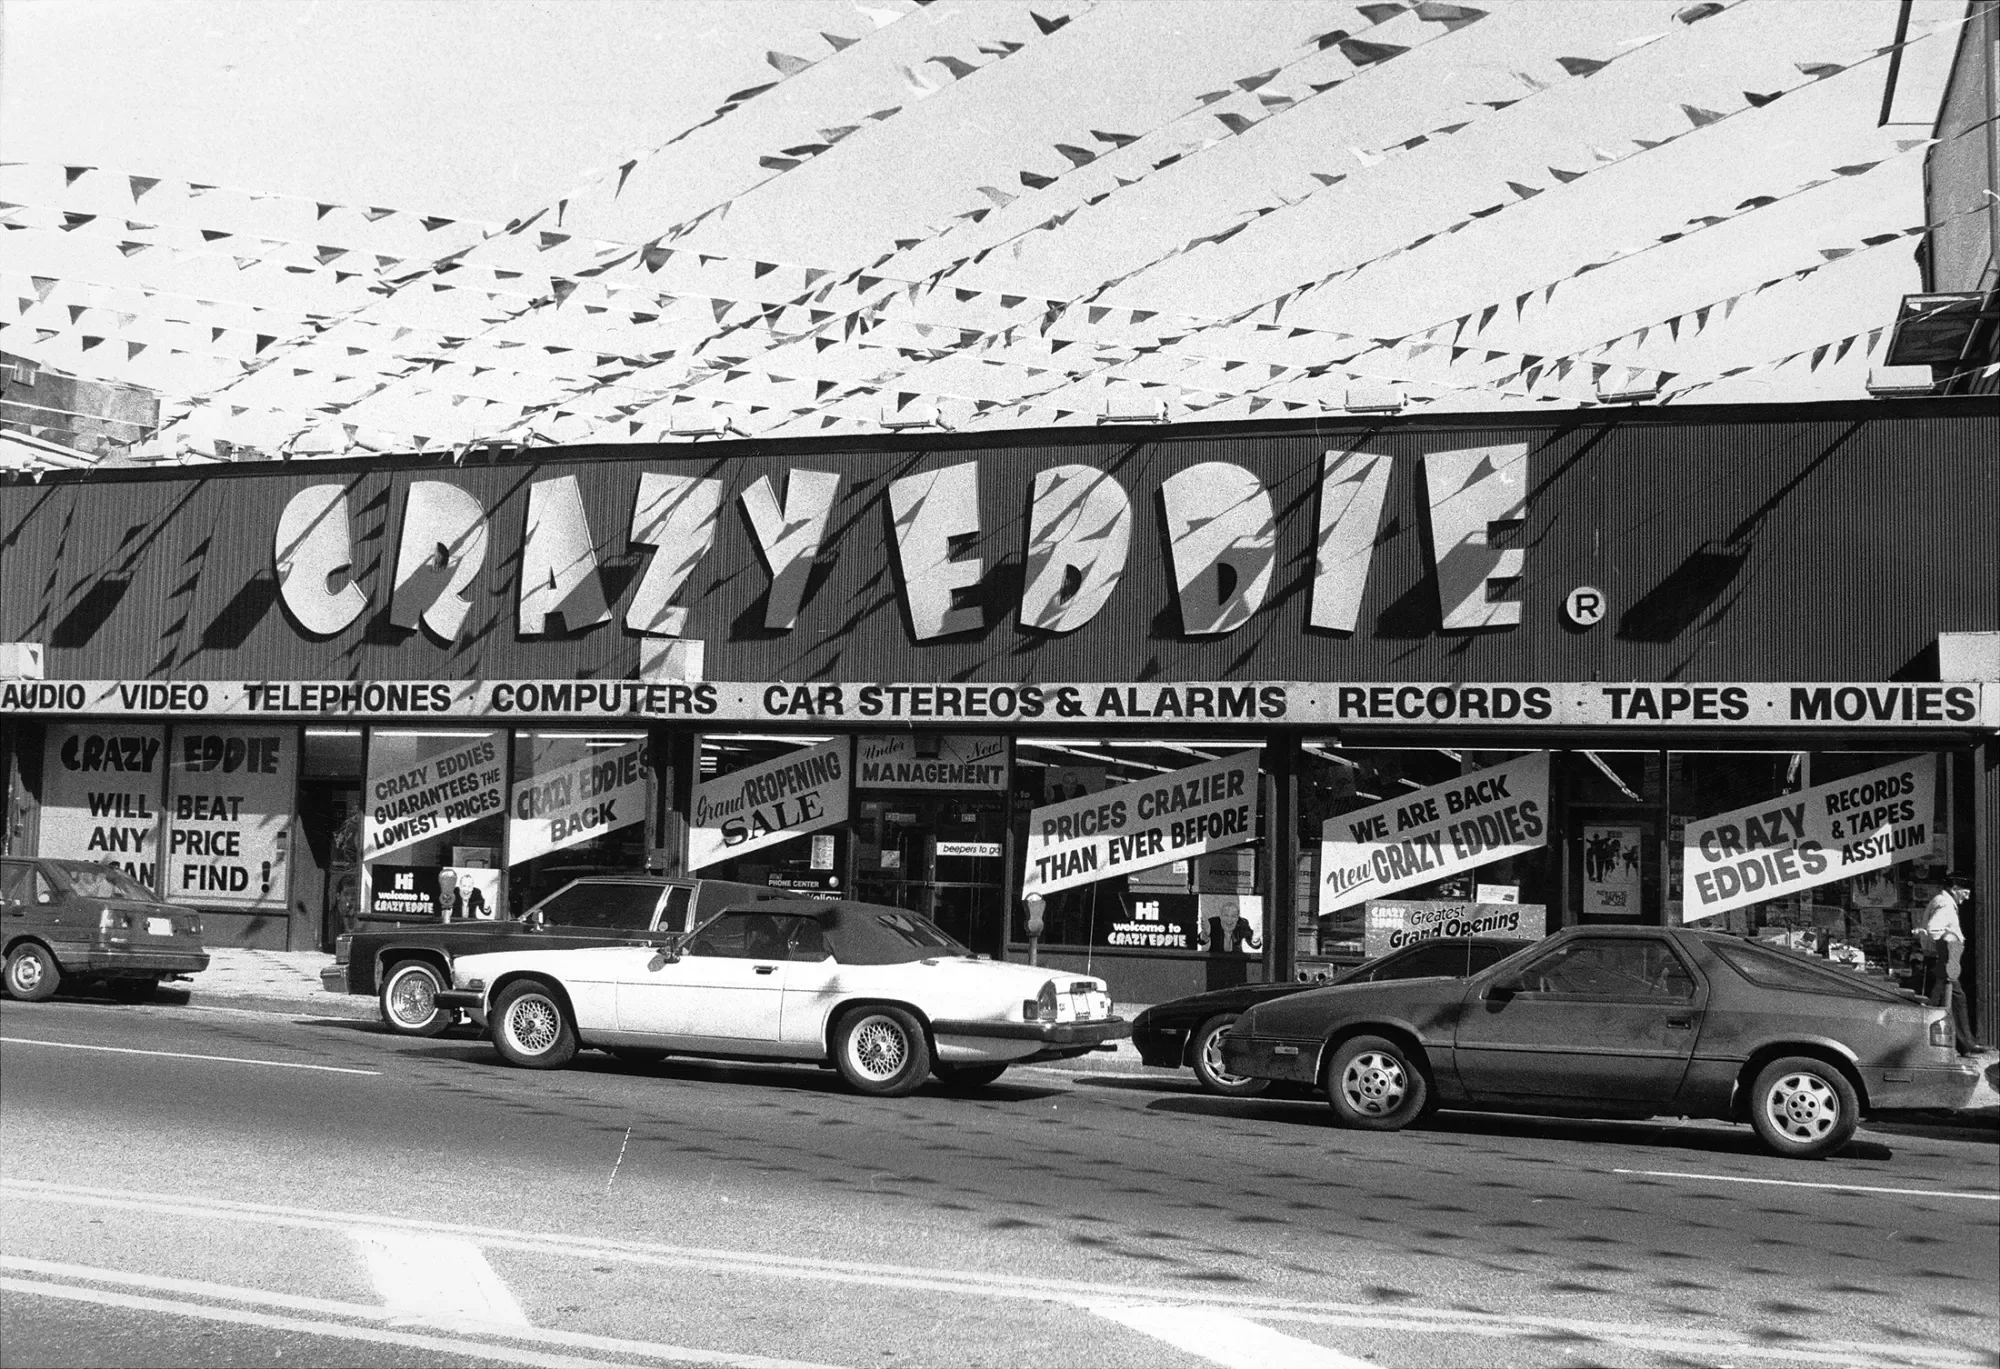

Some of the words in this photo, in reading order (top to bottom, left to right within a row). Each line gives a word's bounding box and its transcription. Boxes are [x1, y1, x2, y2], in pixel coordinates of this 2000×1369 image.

[275, 468, 841, 642] CRAZY
[888, 443, 1528, 641] EDDIE
[1, 684, 86, 709] AUDIO
[120, 684, 208, 710] VIDEO
[243, 684, 451, 712] TELEPHONES
[491, 683, 718, 715] COMPUTERS
[763, 685, 844, 716] CAR
[858, 686, 1044, 718] STEREOS
[1056, 687, 1087, 717] &
[1095, 687, 1287, 718] ALARMS
[1338, 686, 1552, 720] RECORDS
[1603, 687, 1749, 720] TAPES
[1789, 687, 1976, 721] MOVIES
[60, 735, 161, 772] CRAZY
[183, 735, 281, 774] EDDIE
[864, 737, 905, 760] Under
[966, 738, 1000, 759] New
[375, 765, 428, 801] CRAZY
[695, 785, 746, 828] Grand
[743, 751, 842, 808] REOPENING
[861, 762, 1005, 785] MANAGEMENT
[87, 792, 153, 819] WILL
[176, 795, 244, 822] BEAT
[374, 772, 480, 825] GUARANTEES
[480, 768, 501, 787] THE
[516, 773, 573, 820] CRAZY
[1042, 801, 1127, 847] PRICES
[1137, 769, 1245, 821] CRAZIER
[1349, 814, 1389, 845] WE
[1397, 797, 1440, 833] ARE
[1445, 774, 1512, 814] BACK
[1824, 772, 1915, 816] RECORDS
[373, 810, 439, 850] LOWEST
[444, 788, 501, 824] PRICES
[550, 798, 618, 843] BACK
[719, 791, 824, 848] SALE
[1698, 803, 1806, 864] CRAZY
[1831, 819, 1845, 840] &
[1845, 799, 1915, 836] TAPES
[87, 826, 150, 853] ANY
[170, 829, 241, 857] PRICE
[942, 844, 977, 855] beepers
[978, 844, 987, 854] to
[1035, 844, 1099, 886] THAN
[1108, 827, 1164, 866] EVER
[1171, 804, 1249, 850] BEFORE
[1326, 858, 1374, 894] New
[1371, 828, 1445, 885] CRAZY
[1448, 800, 1544, 861] EDDIES
[1840, 824, 1926, 866] ASSYLUM
[182, 864, 249, 892] FIND
[395, 873, 414, 890] Hi
[1693, 837, 1828, 906] EDDIE'S
[374, 901, 404, 911] CRAZY
[405, 902, 434, 913] EDDIE
[378, 890, 417, 900] welcome
[420, 892, 430, 900] to
[1135, 901, 1160, 921] Hi
[1112, 921, 1167, 934] welcome
[1168, 922, 1182, 934] to
[1389, 921, 1443, 949] Grand
[1445, 910, 1520, 937] Opening
[1410, 904, 1466, 926] Greatest
[1107, 932, 1149, 946] CRAZY
[1149, 934, 1188, 948] EDDIE
